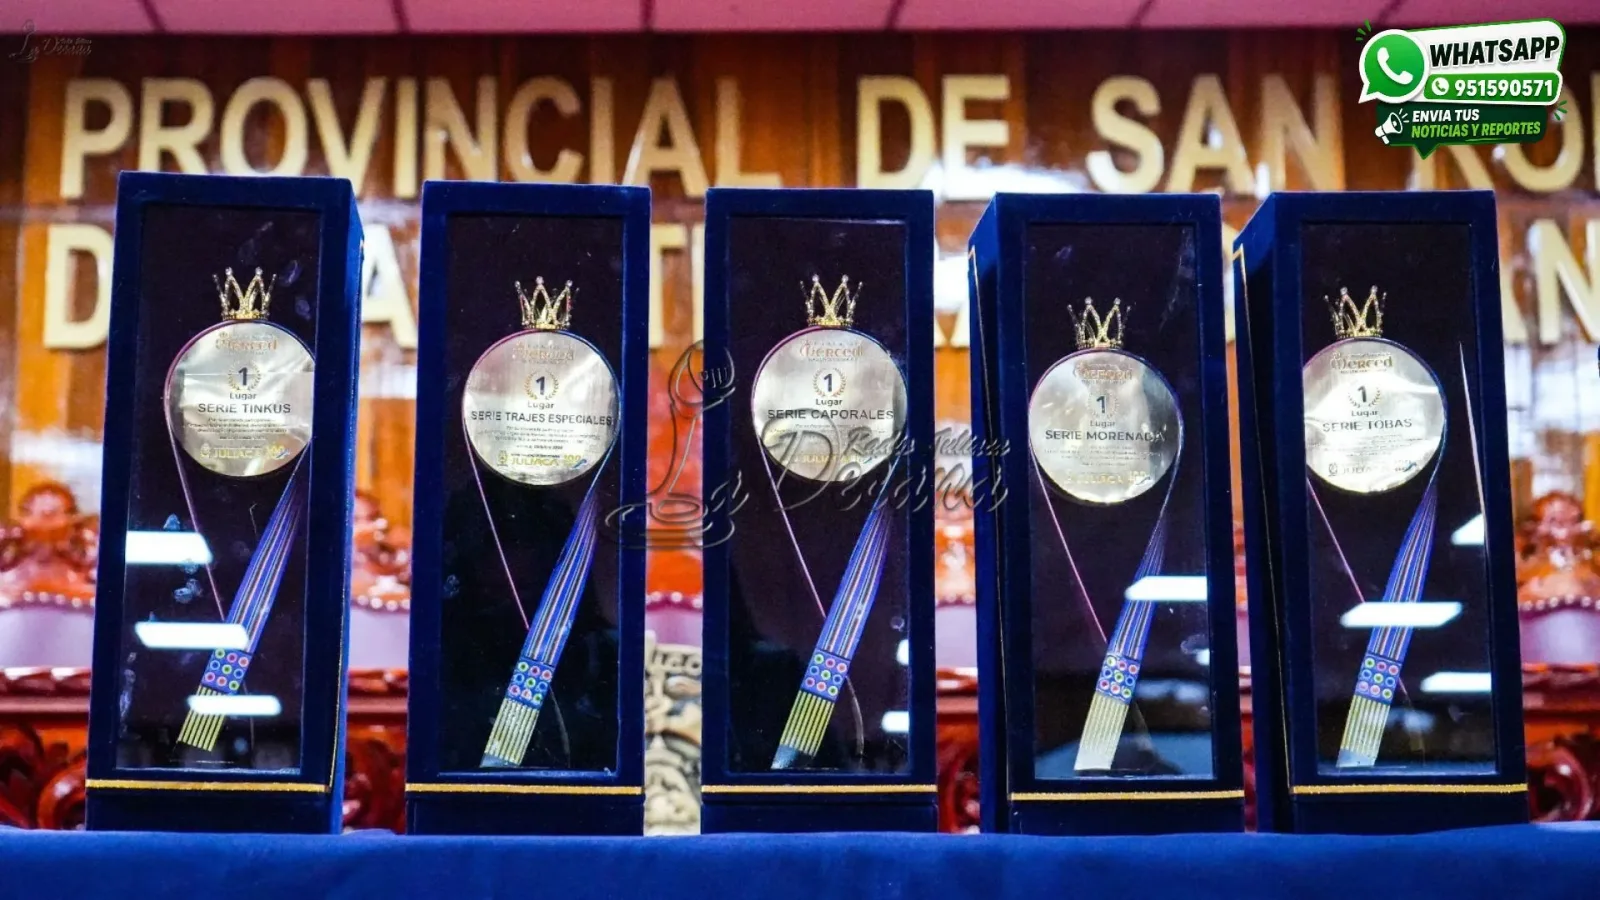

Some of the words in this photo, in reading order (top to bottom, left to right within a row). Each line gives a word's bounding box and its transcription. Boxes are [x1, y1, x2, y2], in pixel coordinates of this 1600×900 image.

[60, 75, 783, 200] PROVINCIAL
[857, 75, 1010, 190] DE
[1085, 73, 1343, 193] SAN
[238, 367, 248, 386] 1
[824, 373, 833, 392] 1
[536, 376, 546, 395] 1
[229, 392, 257, 400] Lugar
[1357, 385, 1367, 403] 1
[198, 403, 237, 414] SERIE
[242, 403, 291, 414] TINKUS
[527, 401, 555, 410] Lugar
[815, 398, 843, 406] Lugar
[1096, 396, 1106, 414] 1
[471, 410, 501, 421] SERIE
[505, 412, 545, 423] TRAJES
[548, 413, 613, 425] ESPECIALES
[767, 409, 807, 419] SERIE
[811, 409, 894, 420] CAPORALES
[1351, 409, 1379, 417] Lugar
[1090, 420, 1115, 428] Lugar
[1322, 421, 1362, 432] SERIE
[1367, 418, 1412, 430] TOBAS
[1045, 430, 1082, 440] SERIE
[1086, 431, 1165, 442] MORENADA
